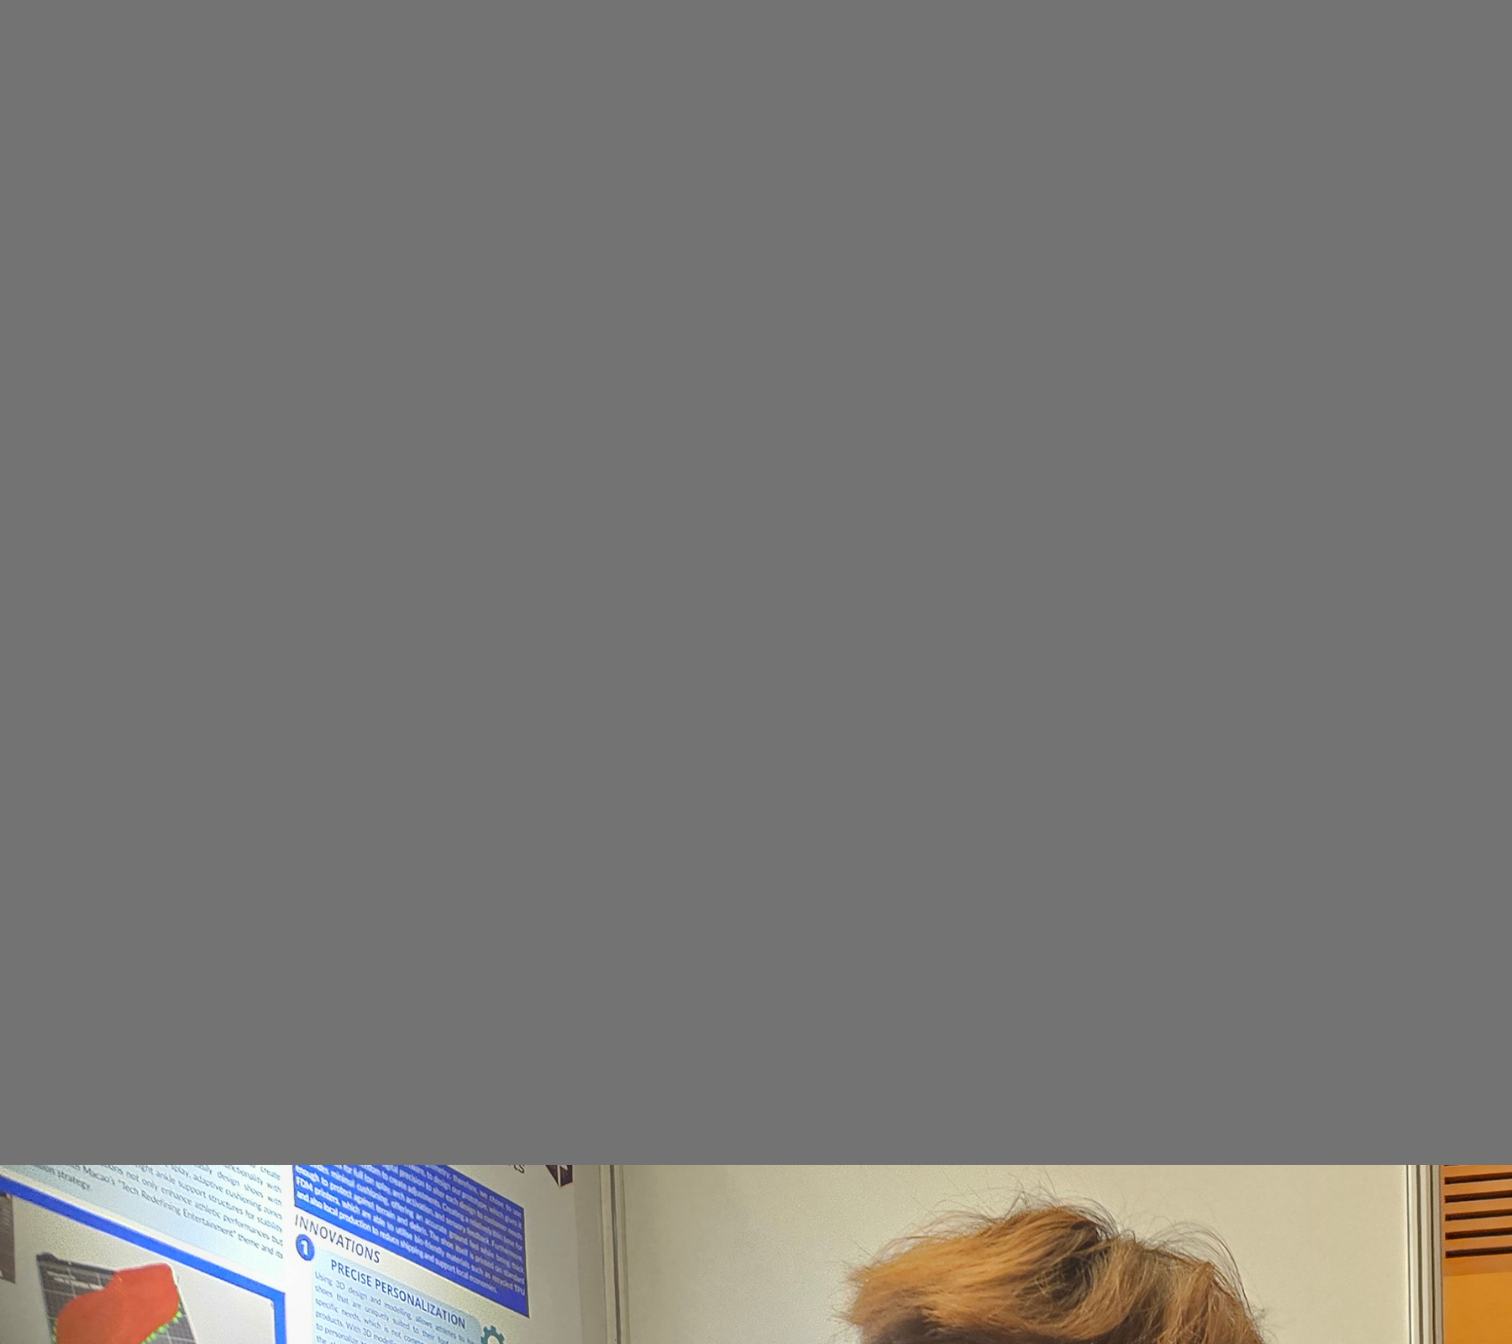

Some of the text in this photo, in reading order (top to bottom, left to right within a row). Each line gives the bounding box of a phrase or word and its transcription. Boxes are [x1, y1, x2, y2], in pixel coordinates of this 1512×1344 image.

[294, 1212, 380, 1265] INNOVATIONS
[331, 1258, 465, 1329] PRECISE PERSONALIZATION
